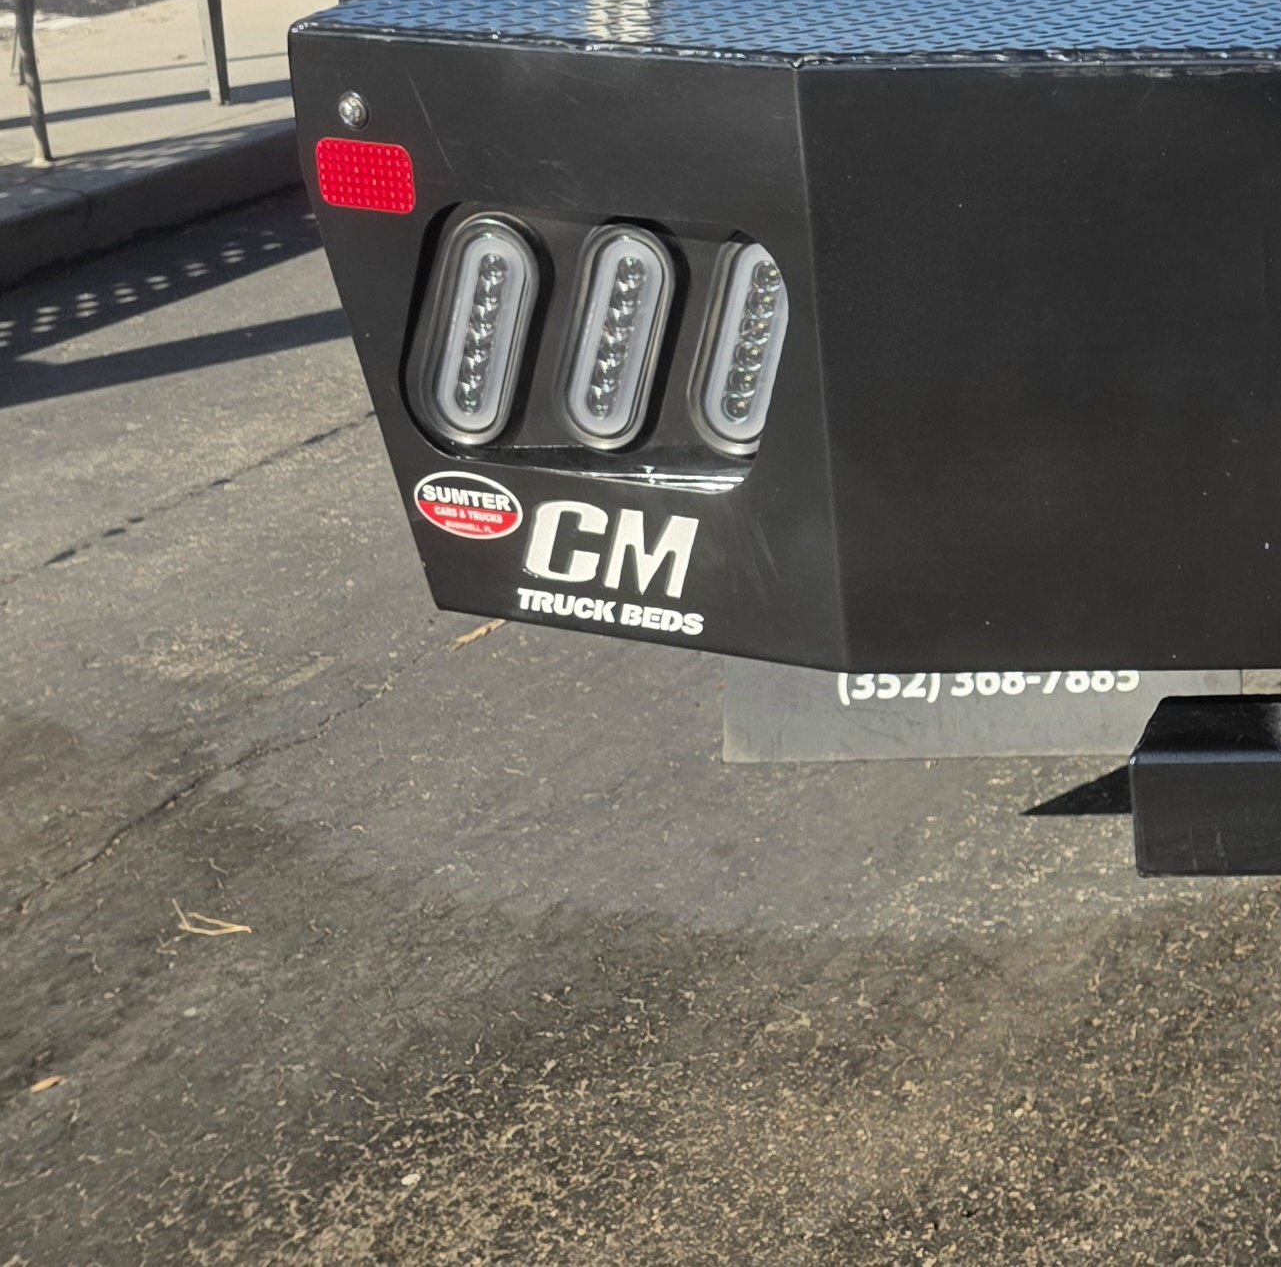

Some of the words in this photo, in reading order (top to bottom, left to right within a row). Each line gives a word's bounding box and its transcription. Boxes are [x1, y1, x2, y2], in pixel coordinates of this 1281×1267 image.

[422, 483, 512, 512] SUMTER
[434, 505, 458, 518] CARS
[467, 510, 504, 524] TRUCKS
[522, 500, 700, 599] CM
[517, 587, 617, 623] TRUCK
[620, 603, 705, 636] BEDS
[837, 672, 941, 706] (352)
